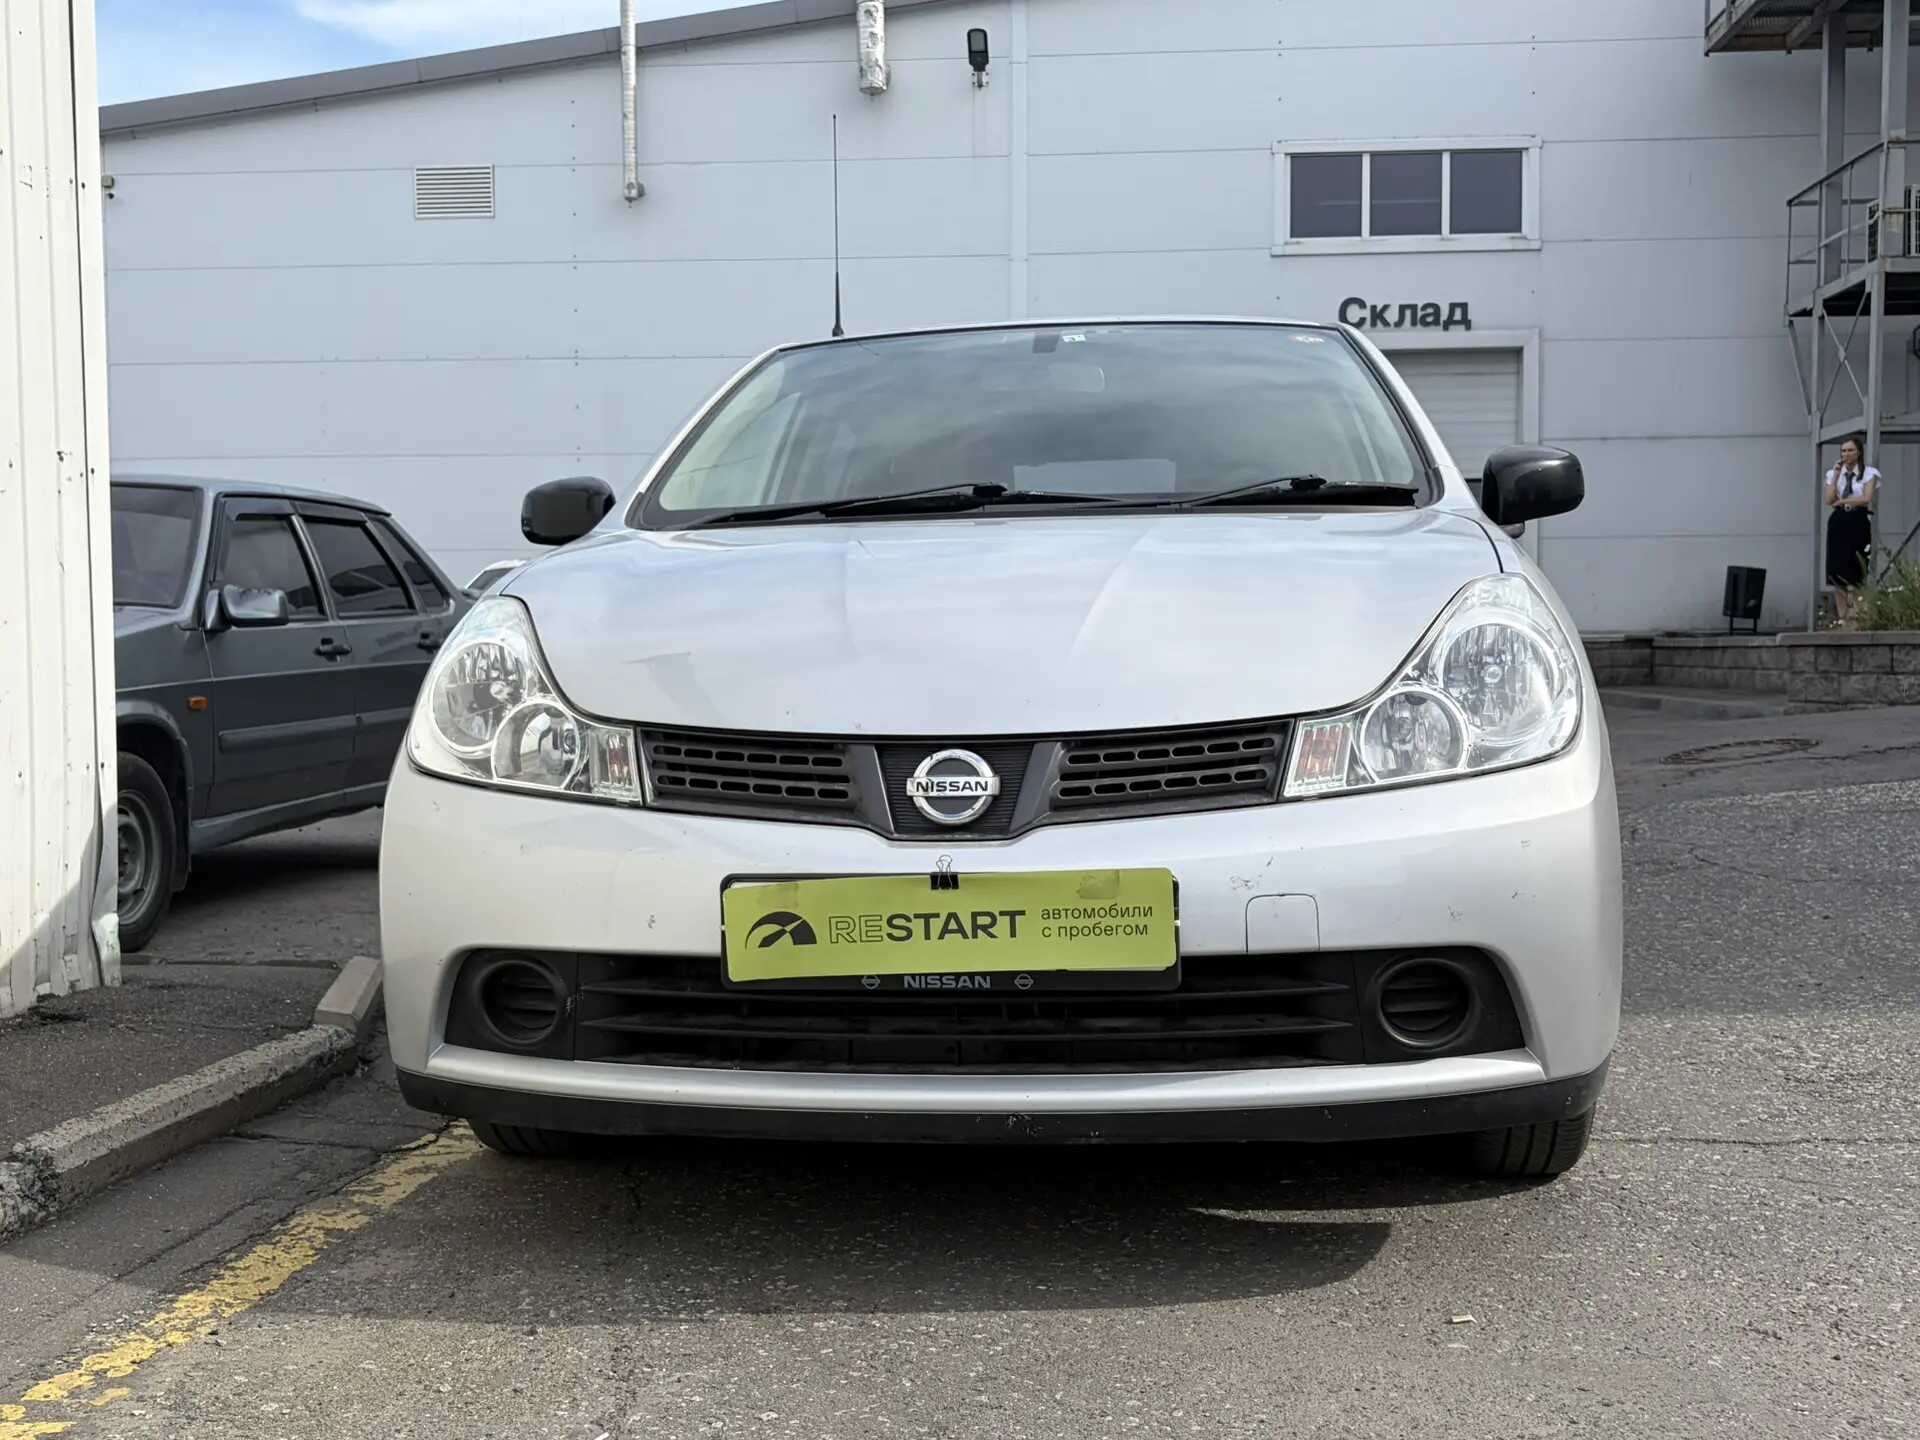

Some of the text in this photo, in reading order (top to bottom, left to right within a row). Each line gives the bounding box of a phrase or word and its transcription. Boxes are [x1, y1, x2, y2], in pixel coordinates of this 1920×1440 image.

[1338, 297, 1472, 331] Склад
[916, 780, 989, 793] NISSAN
[1040, 903, 1153, 921] автомобили
[828, 909, 1027, 944] RESTART
[1041, 921, 1149, 941] с пробегом
[903, 975, 992, 989] NISSAN
